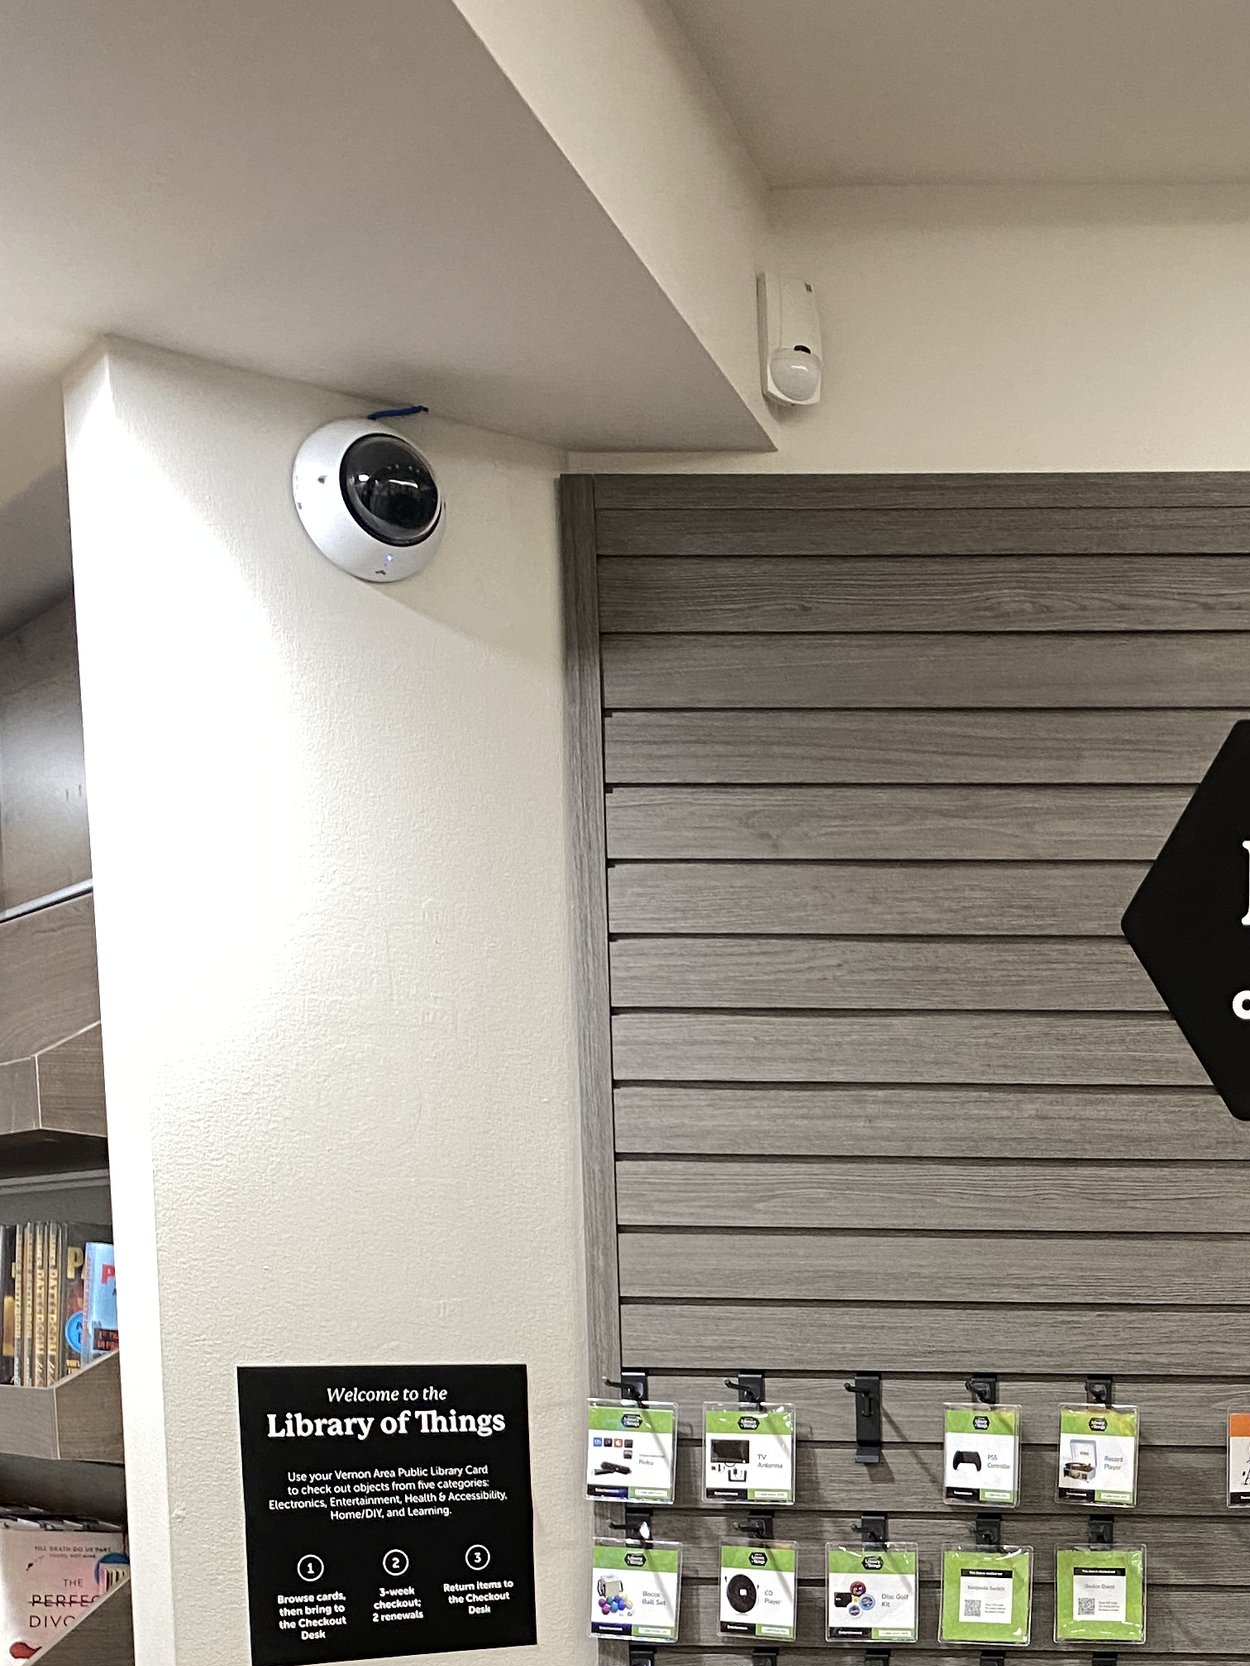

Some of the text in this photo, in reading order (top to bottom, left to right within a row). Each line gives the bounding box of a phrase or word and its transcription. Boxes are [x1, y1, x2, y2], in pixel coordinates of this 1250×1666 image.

[327, 1386, 448, 1403] Welcome to the
[267, 1409, 506, 1440] Library of Things
[288, 1464, 488, 1483] Use your Vernon Area Public Library Card
[288, 1478, 489, 1496] to check out objects from five categories:
[268, 1499, 327, 1510] Electronics,
[330, 1495, 402, 1507] Entertainment,
[404, 1493, 437, 1503] Health
[438, 1492, 446, 1501] &
[330, 1506, 452, 1520] Home/DIY, and Learning.
[392, 1557, 400, 1569] 2
[474, 1552, 482, 1563] 3
[307, 1563, 315, 1574] 1
[64, 1579, 83, 1587] THE
[443, 1580, 514, 1592] Return items to
[277, 1591, 346, 1604] Browse cards,
[379, 1586, 415, 1597] 3-week
[373, 1598, 422, 1610] checkout;
[448, 1592, 510, 1604] the Checkout
[279, 1604, 345, 1617] then bring to
[372, 1610, 424, 1622] 2 renewals
[468, 1605, 491, 1615] Desk
[279, 1616, 347, 1630] the Checkout
[301, 1630, 326, 1640] Desk
